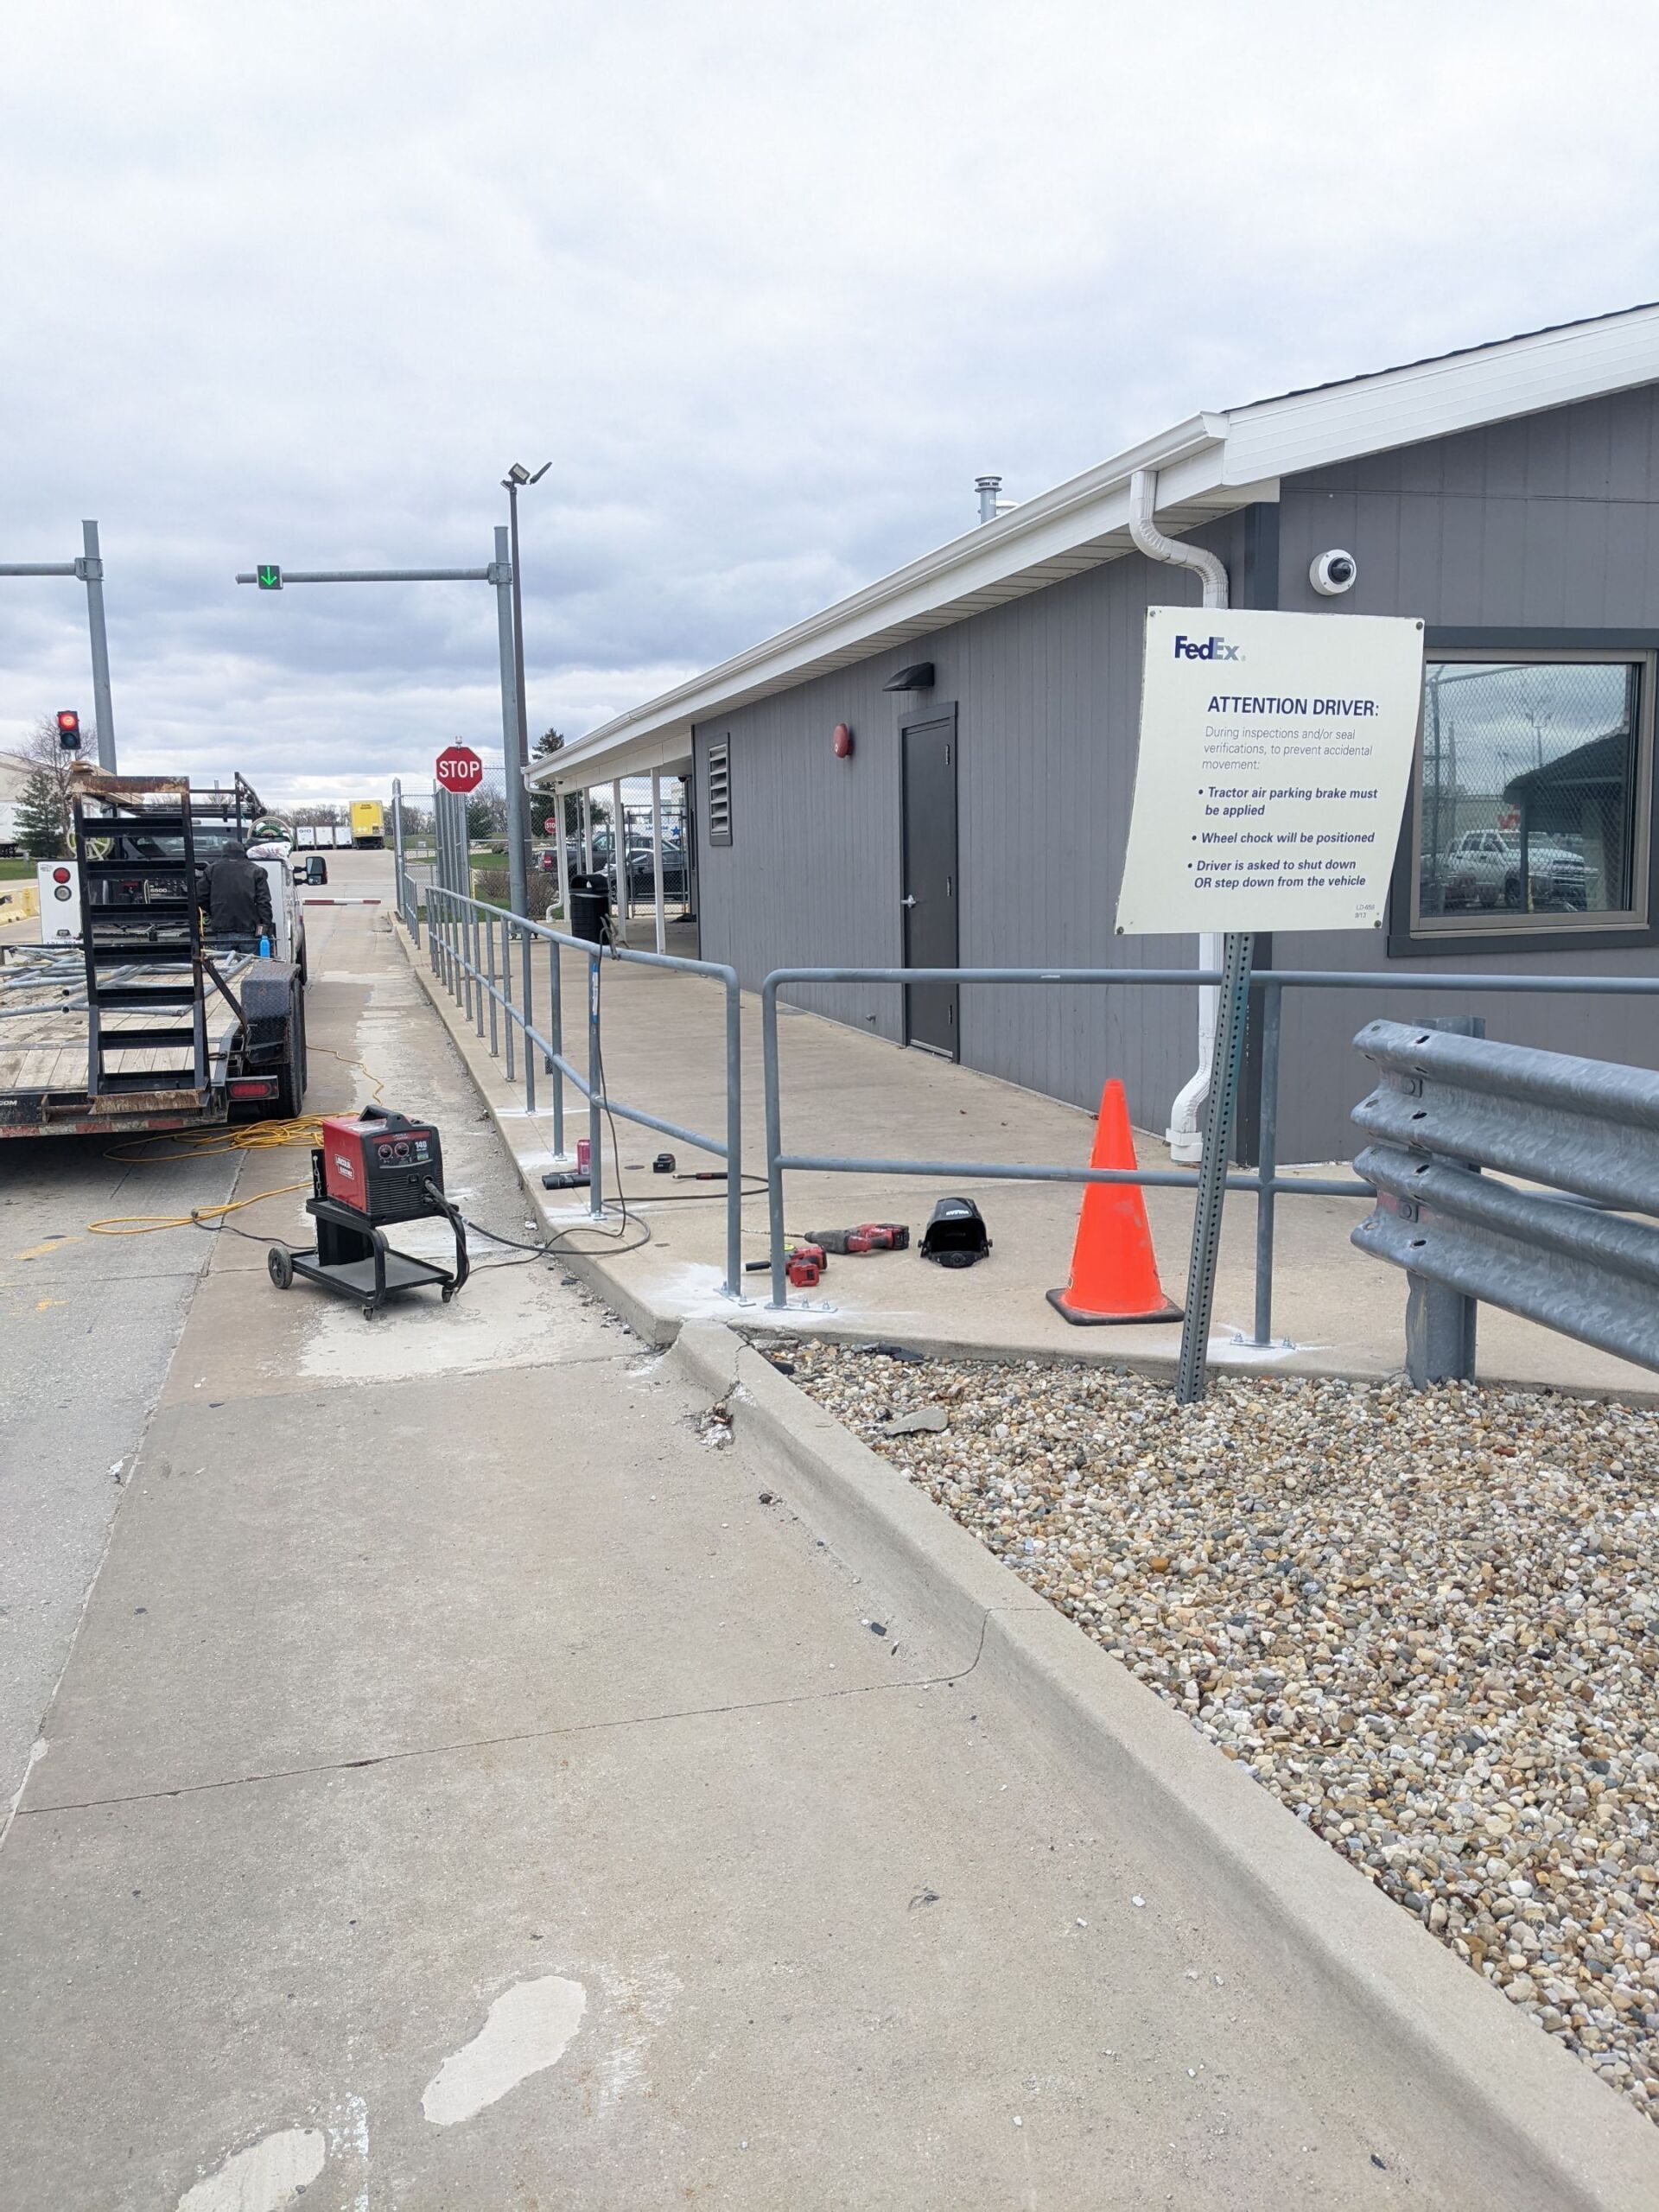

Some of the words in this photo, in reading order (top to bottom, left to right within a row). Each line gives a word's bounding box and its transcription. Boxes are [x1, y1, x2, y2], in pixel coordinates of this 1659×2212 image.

[1175, 635, 1239, 660] FedEx
[1207, 696, 1308, 715] ATTENTION
[1313, 699, 1379, 716] DRIVER:
[1205, 726, 1239, 740] During
[1242, 727, 1299, 740] inspections
[1301, 728, 1332, 741] and/or
[1335, 729, 1356, 741] seal
[1204, 742, 1268, 756] verifications,
[1270, 744, 1281, 754] to
[1283, 746, 1321, 756] prevent
[1324, 744, 1373, 756] accidental
[439, 760, 480, 778] STOP
[1202, 760, 1261, 770] movement:
[1208, 786, 1249, 798] Tractor
[1251, 787, 1267, 798] air
[1269, 787, 1313, 801] parking
[1315, 788, 1347, 799] brake
[1350, 789, 1378, 799] must
[1205, 804, 1219, 816] be
[1223, 804, 1266, 818] applied
[1202, 832, 1237, 843] Wheel
[1240, 832, 1273, 843] chock
[1276, 832, 1297, 843] will
[1300, 832, 1314, 843] be
[1316, 832, 1376, 845] positioned
[1197, 861, 1231, 871] Driver
[1235, 861, 1244, 870] is
[1247, 860, 1281, 870] asked
[1283, 860, 1295, 869] to
[1298, 859, 1322, 869] shut
[1325, 859, 1357, 869] down
[1194, 877, 1212, 888] OR
[1215, 878, 1240, 890] step
[1243, 877, 1274, 887] down
[1277, 876, 1304, 887] from
[1307, 876, 1325, 887] the
[1328, 875, 1366, 886] vehicle
[415, 1141, 427, 1149] 140
